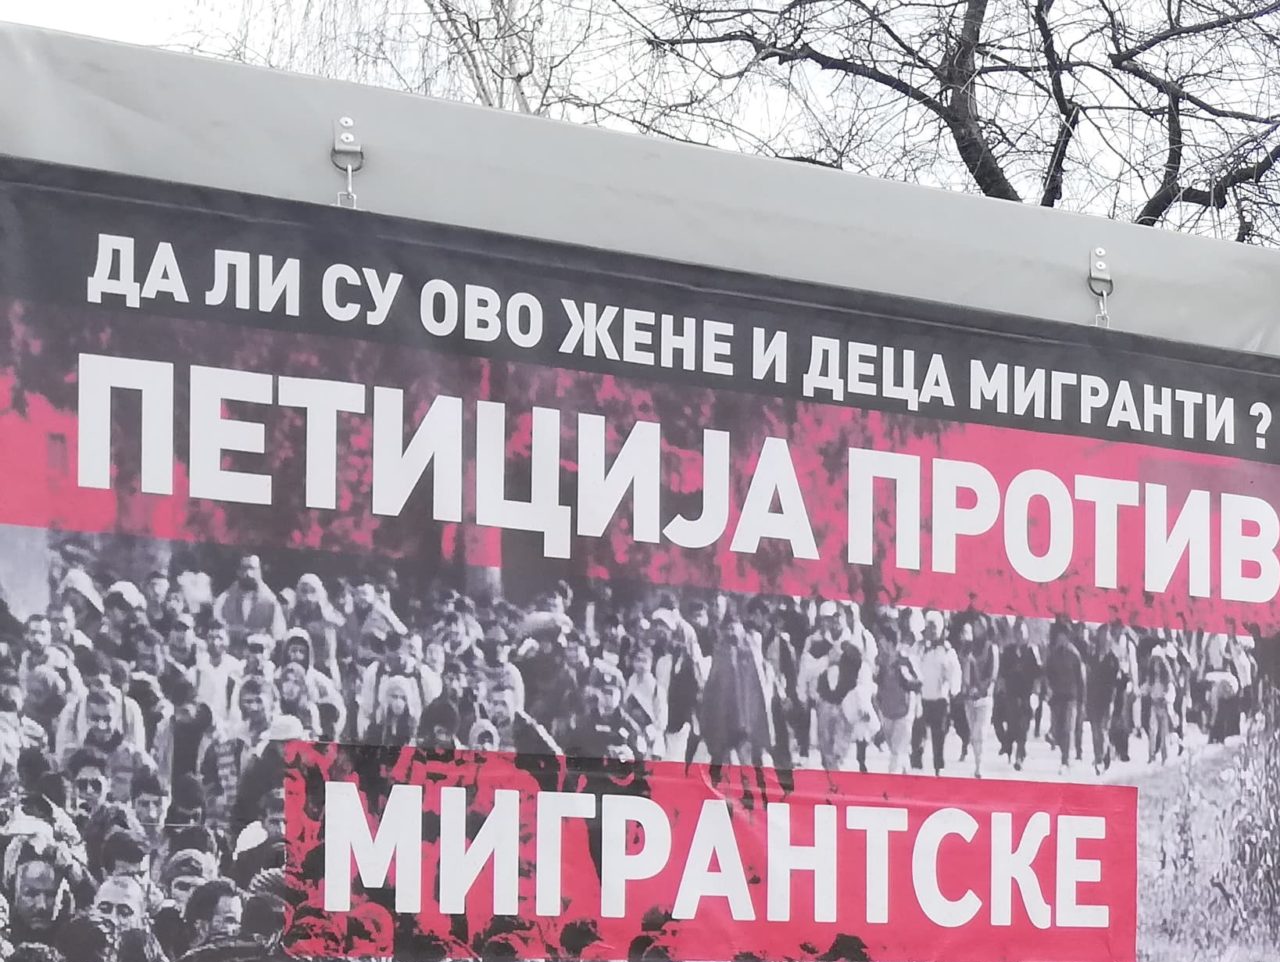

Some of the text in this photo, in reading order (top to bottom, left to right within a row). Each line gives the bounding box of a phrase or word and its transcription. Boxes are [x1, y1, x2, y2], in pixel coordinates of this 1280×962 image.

[87, 233, 1272, 450] ДА ЛИ СУ ОВО ЖЕНЕ И ДЕЦА МИГРАНТИ ?
[77, 352, 1280, 604] ПЕТИЦИЈА ПРОТИВ
[323, 781, 1110, 930] МИГРАНТСКЕ
